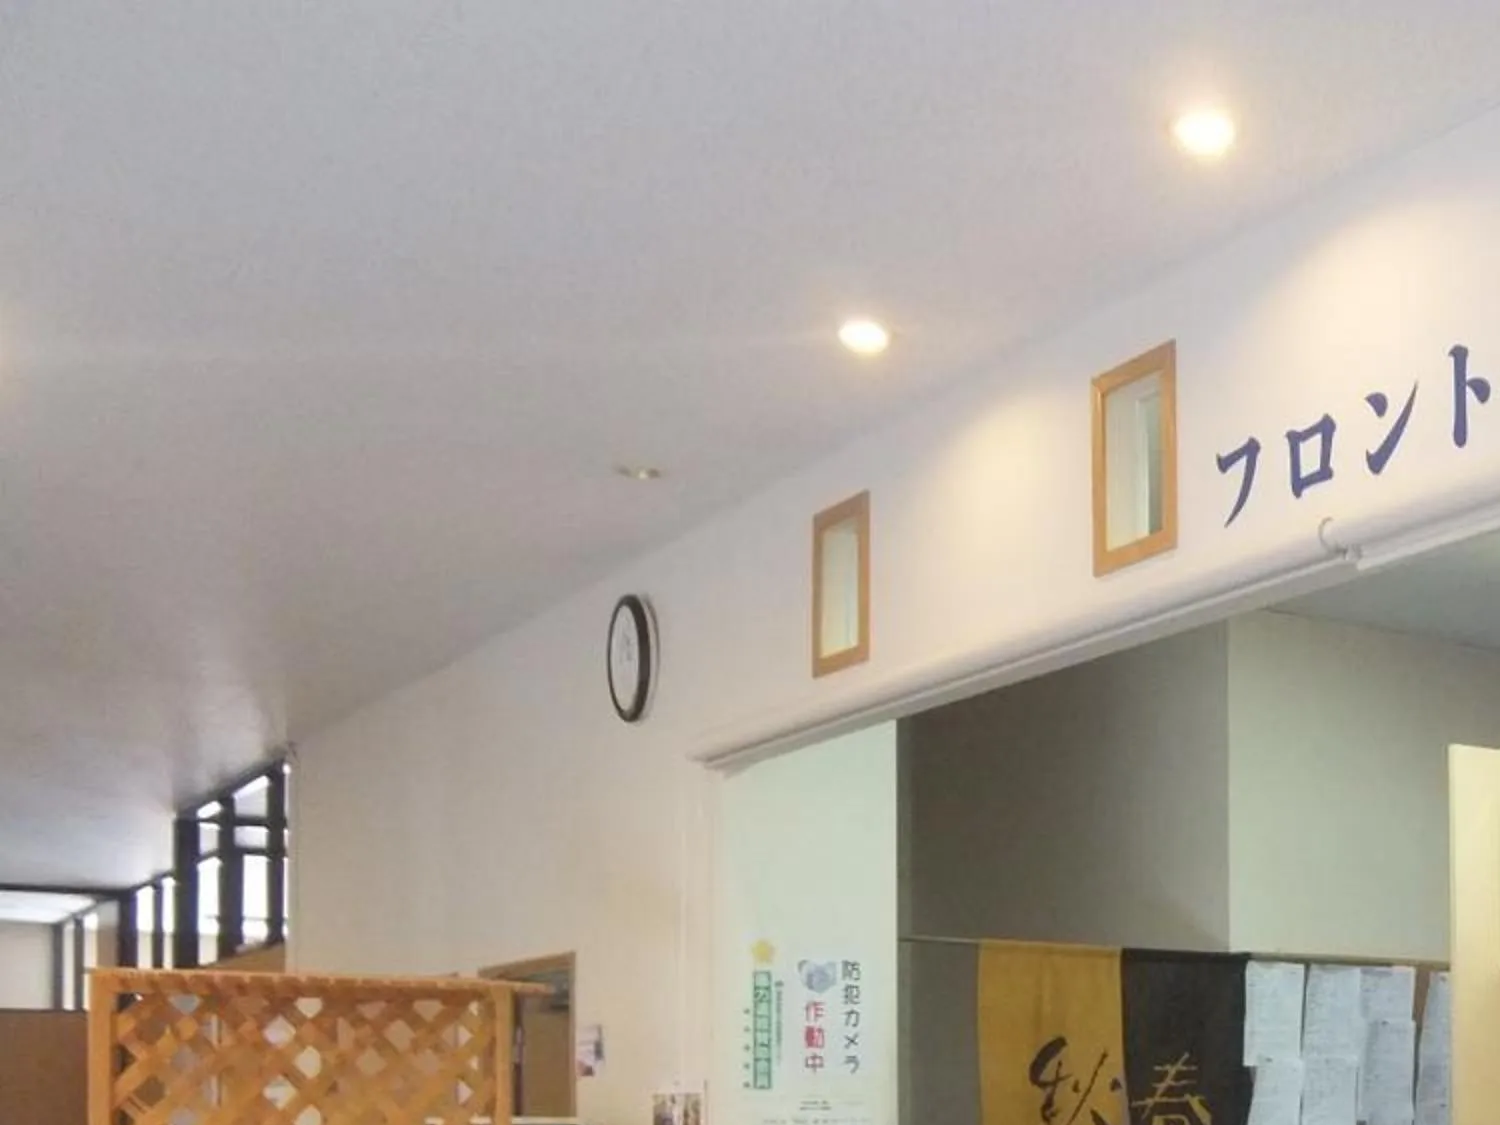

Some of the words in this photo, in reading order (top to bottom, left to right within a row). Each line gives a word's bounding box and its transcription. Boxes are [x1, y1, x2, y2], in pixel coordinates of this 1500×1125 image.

[1215, 344, 1492, 529] フロント
[803, 1001, 826, 1073] 作動中
[841, 960, 862, 1074] 防犯カメラ
